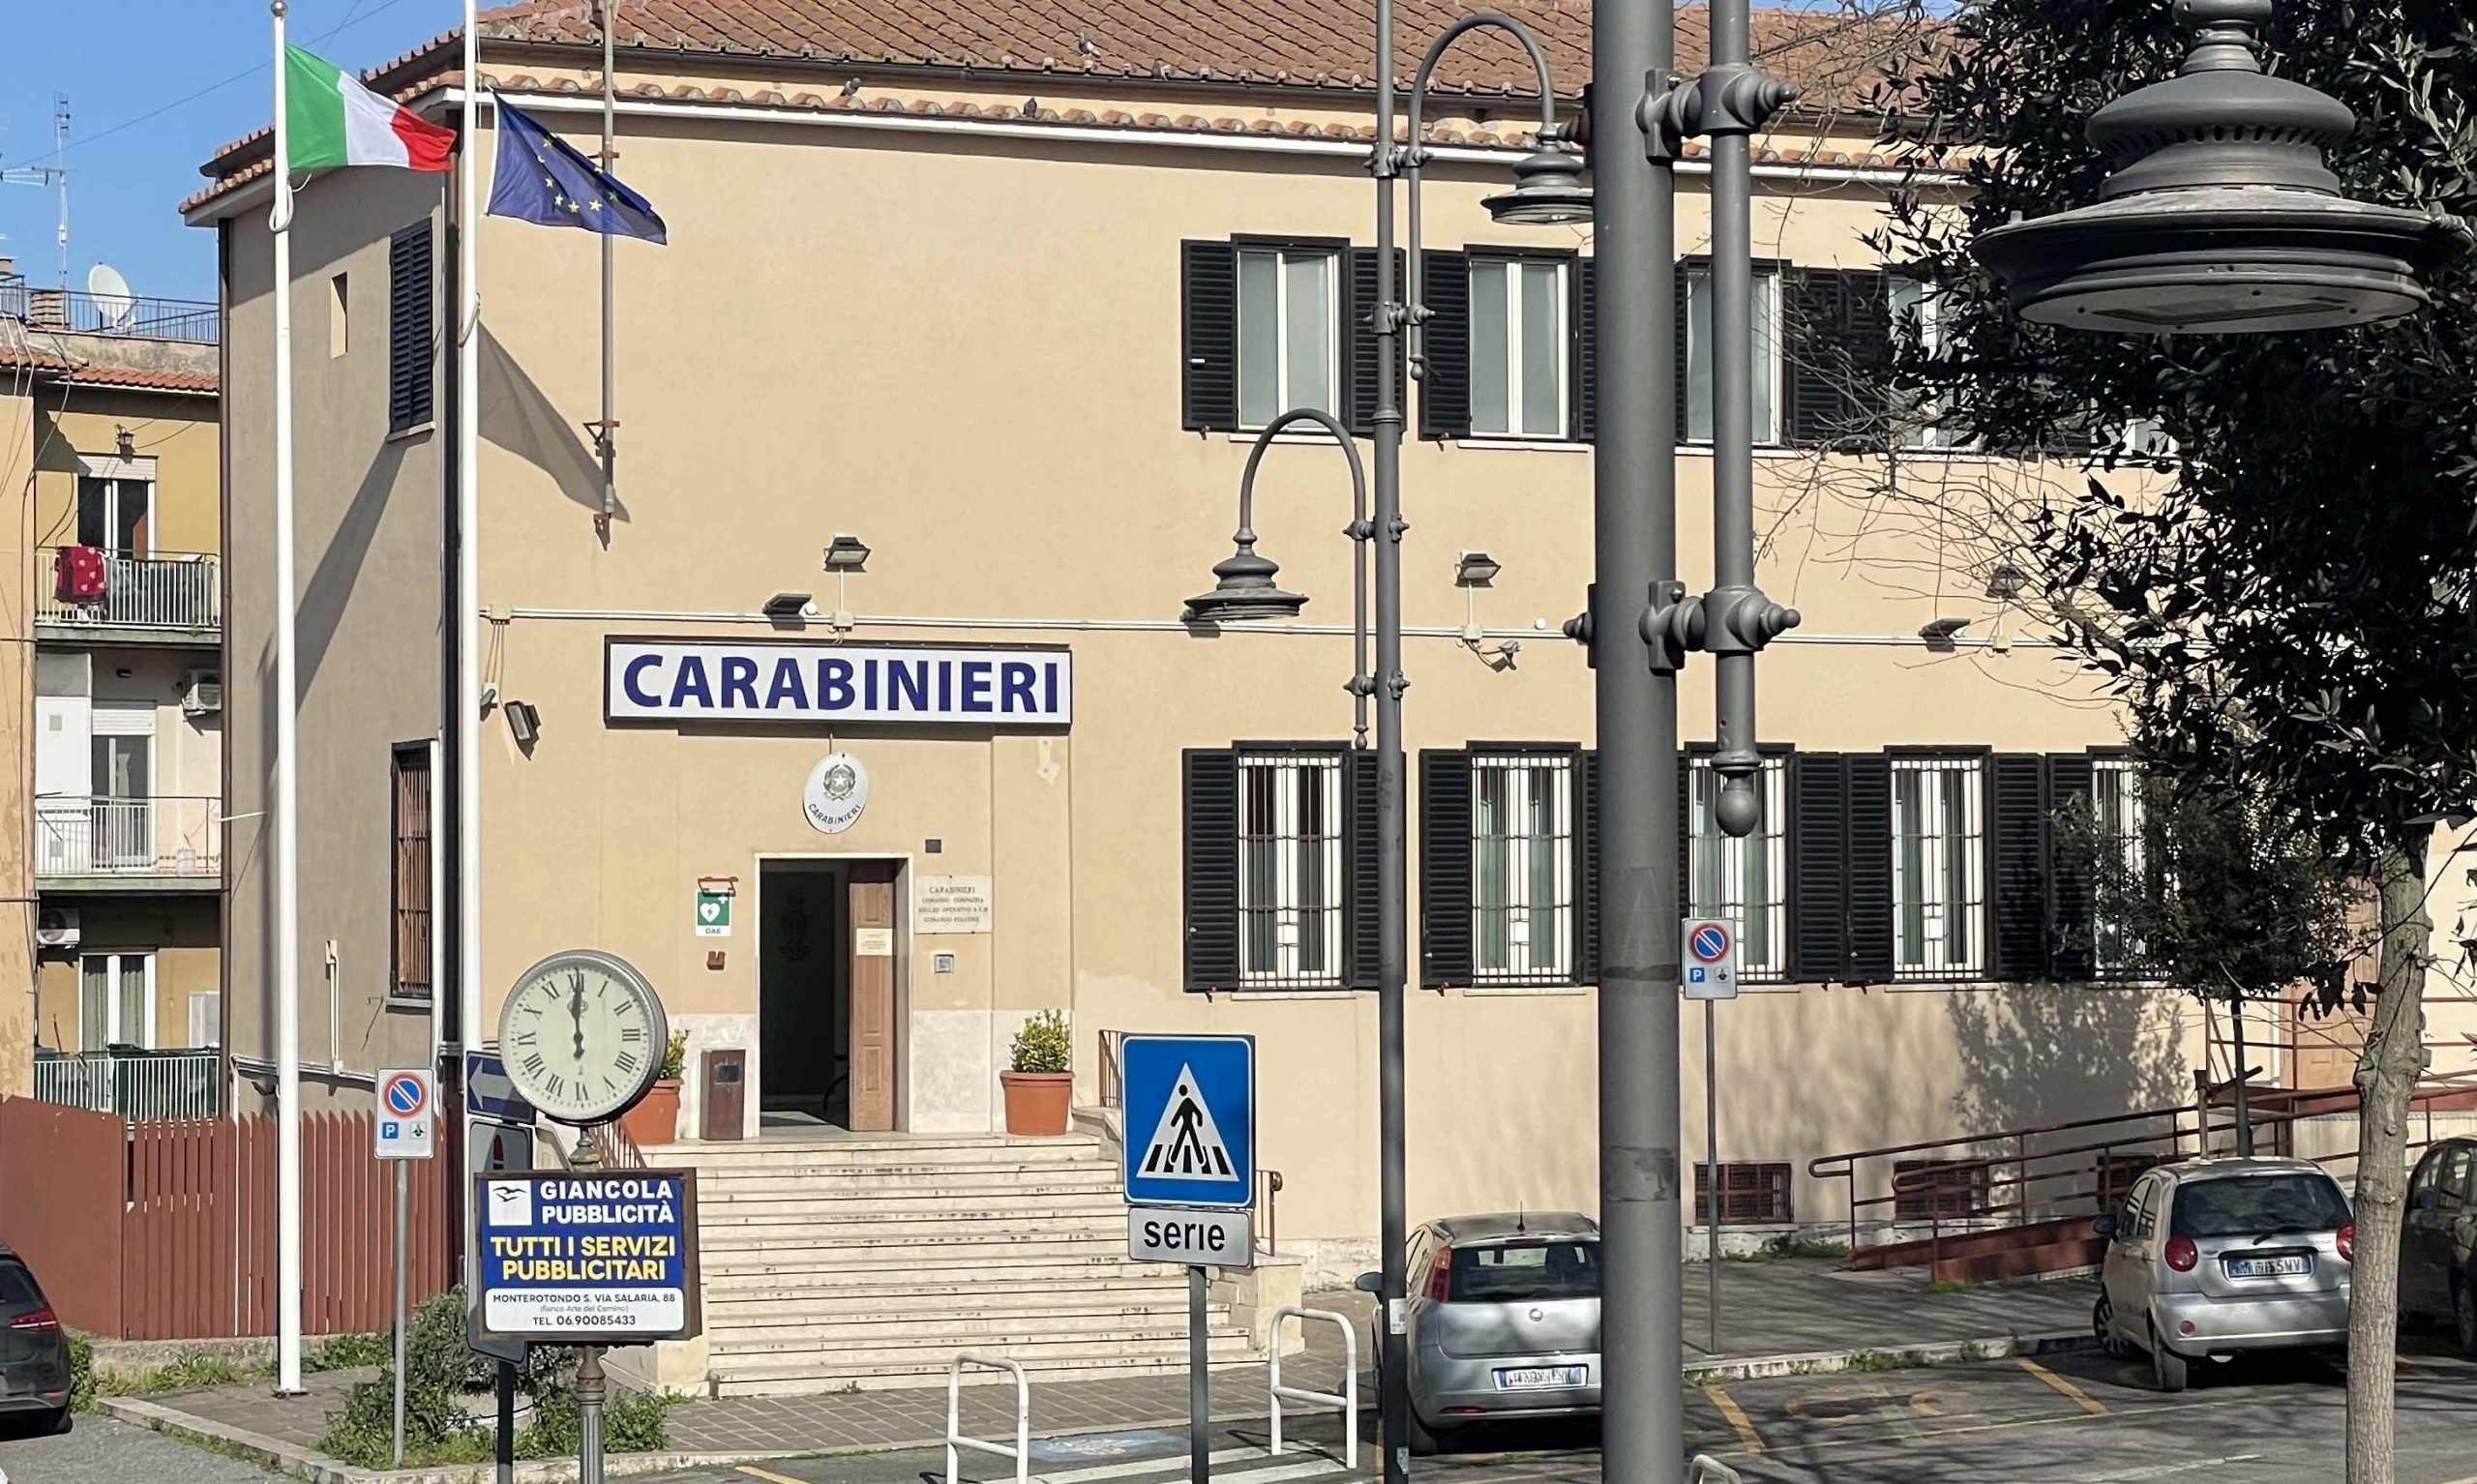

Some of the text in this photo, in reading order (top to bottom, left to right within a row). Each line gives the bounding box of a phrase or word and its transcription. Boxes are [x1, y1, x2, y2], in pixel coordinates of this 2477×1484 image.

[623, 654, 1058, 713] CARABINIERI
[808, 803, 861, 824] CARABINIERI
[540, 1180, 673, 1200] GIANCOLA
[542, 1201, 674, 1224] PUBBLICITÀ
[490, 1236, 675, 1257] TUTTI I SERVIZI
[1144, 1221, 1225, 1251] serie
[502, 1260, 665, 1281] PUBBLICITARI
[492, 1294, 581, 1303] MONTEROTONDO
[583, 1294, 592, 1303] S.
[614, 1293, 660, 1304] SALARIA,
[664, 1293, 675, 1302] 88
[556, 1316, 636, 1325] 06.90085433
